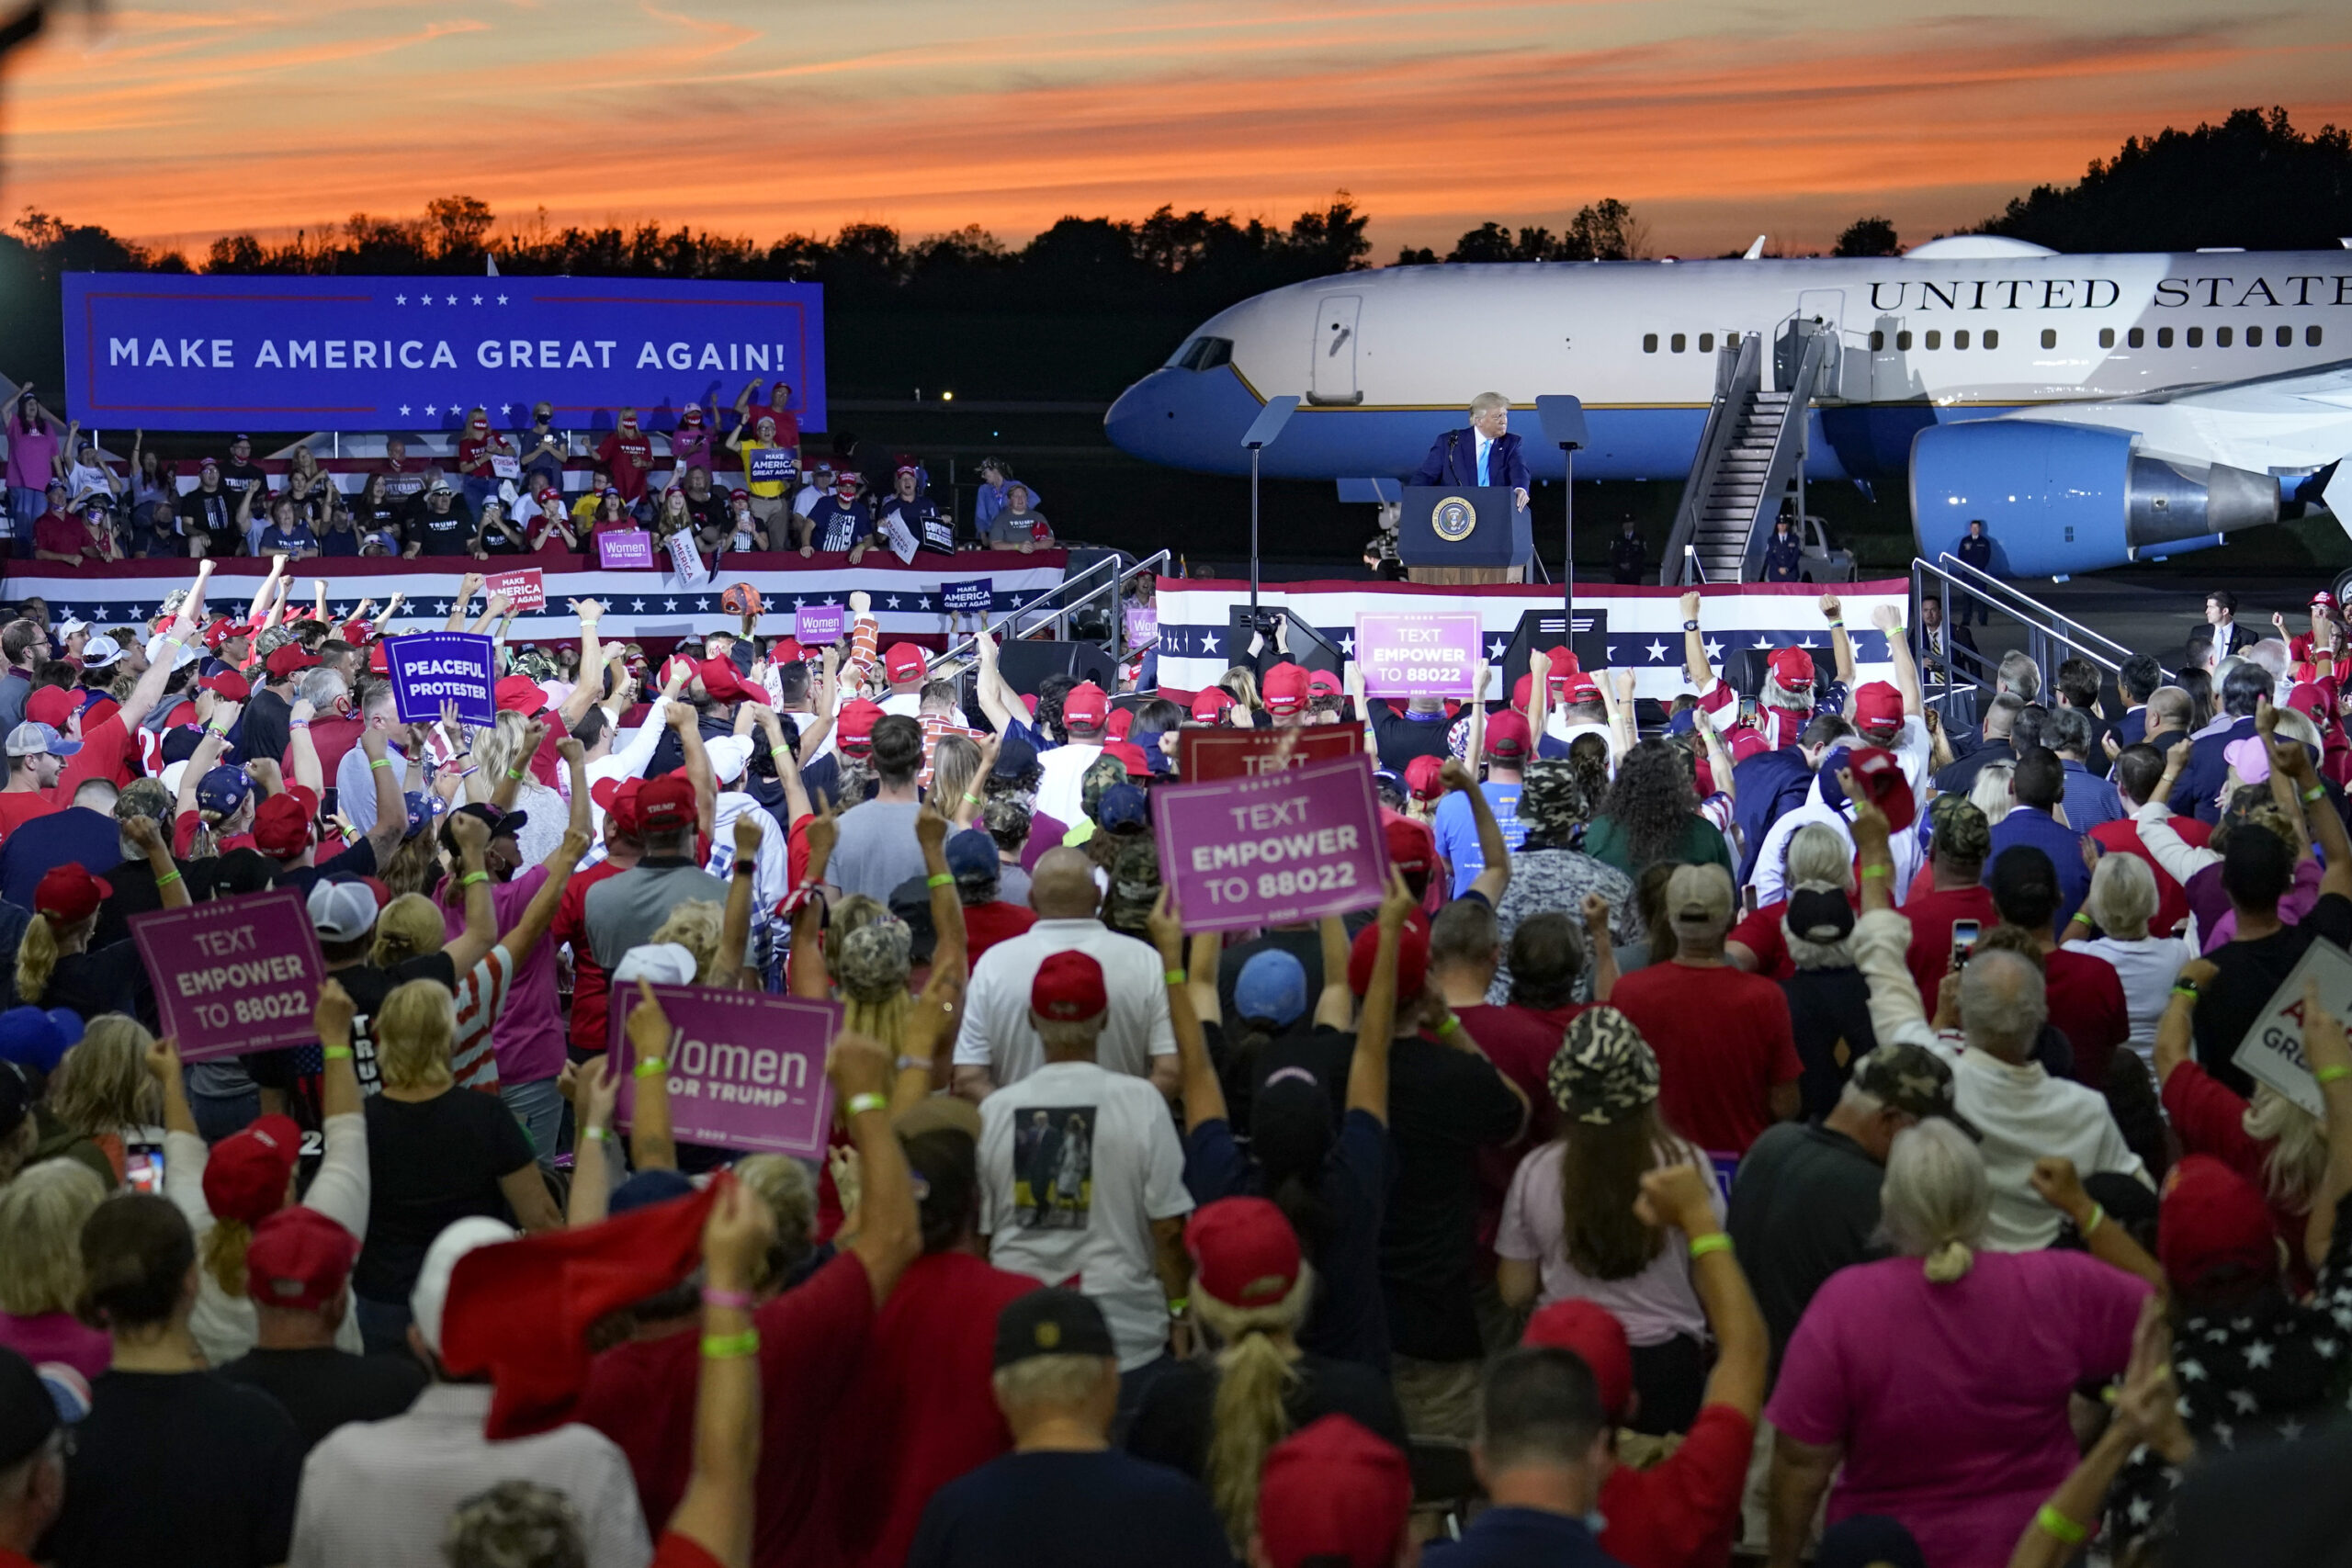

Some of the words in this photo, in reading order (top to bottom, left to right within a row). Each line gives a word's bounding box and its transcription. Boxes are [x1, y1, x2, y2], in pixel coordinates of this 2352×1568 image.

[1868, 278, 2120, 310] UNITED
[109, 337, 235, 367] MAKE
[254, 339, 458, 369] AMERICA
[477, 340, 617, 368] GREAT
[635, 341, 786, 372] AGAIN!
[765, 453, 785, 461] MAKE
[428, 520, 458, 529] TRUMP
[605, 541, 646, 553] Women
[684, 544, 695, 563] MAKE
[673, 537, 694, 581] AMERICA
[502, 577, 526, 586] MAKE
[956, 585, 978, 593] MAKE
[516, 594, 542, 604] AGAIN
[944, 591, 990, 602] AMERICA
[968, 599, 991, 607] AGAIN
[802, 616, 840, 629] Women
[1134, 619, 1157, 632] Wom
[218, 630, 228, 641] 45
[1396, 628, 1442, 643] TEXT
[1374, 648, 1465, 662] EMPOWER
[404, 660, 486, 679] PEACEFUL
[1378, 667, 1402, 682] TO
[1407, 667, 1461, 682] 88022
[409, 682, 487, 700] PROTESTER
[1241, 752, 1309, 778] TEXT
[647, 802, 676, 814] TRUMP
[1229, 795, 1310, 833] TEXT
[1192, 824, 1360, 873] EMPOWER
[1204, 877, 1250, 905] TO
[1257, 862, 1357, 900] 88022
[193, 924, 257, 958] TEXT
[176, 953, 306, 998] EMPOWER
[193, 1002, 230, 1030] TO
[233, 990, 311, 1024] 88022
[352, 1013, 383, 1098] TRUM
[2262, 1026, 2310, 1073] GRE
[666, 1076, 701, 1098] OR
[707, 1080, 788, 1108] TRUMP
